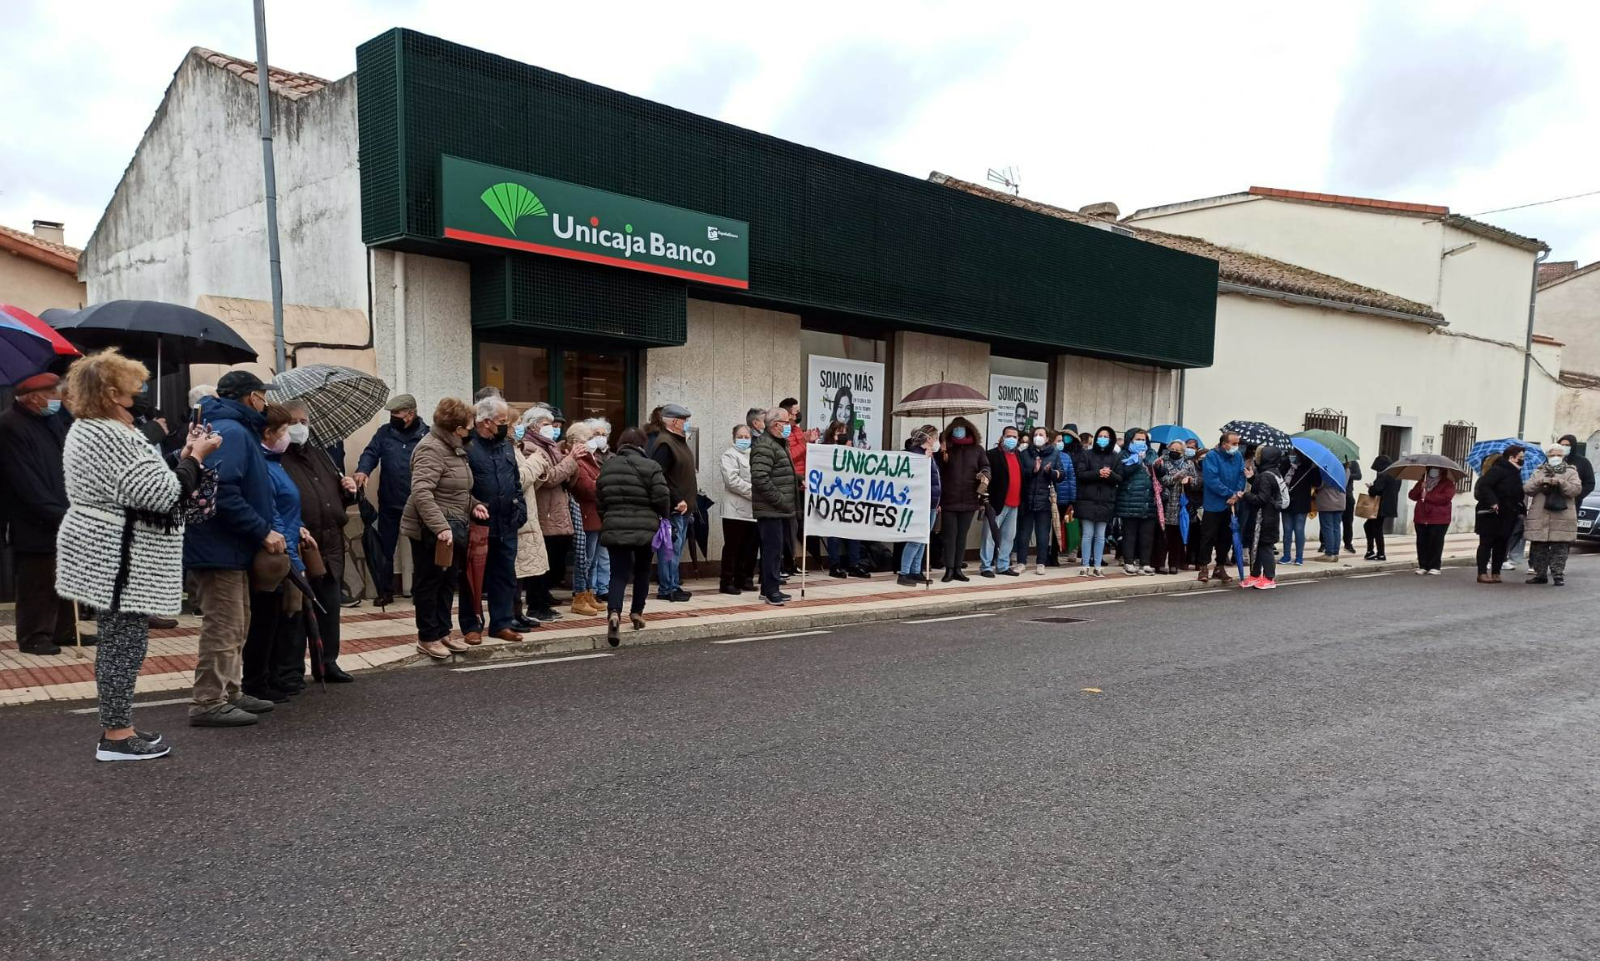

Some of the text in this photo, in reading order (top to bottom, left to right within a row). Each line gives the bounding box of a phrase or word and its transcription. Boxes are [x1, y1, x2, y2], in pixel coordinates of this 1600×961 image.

[552, 213, 716, 267] Unicaja Banco
[820, 370, 874, 392] SOMOS MÁS
[998, 385, 1039, 403] SOMOS MÁS
[807, 493, 830, 519] NO
